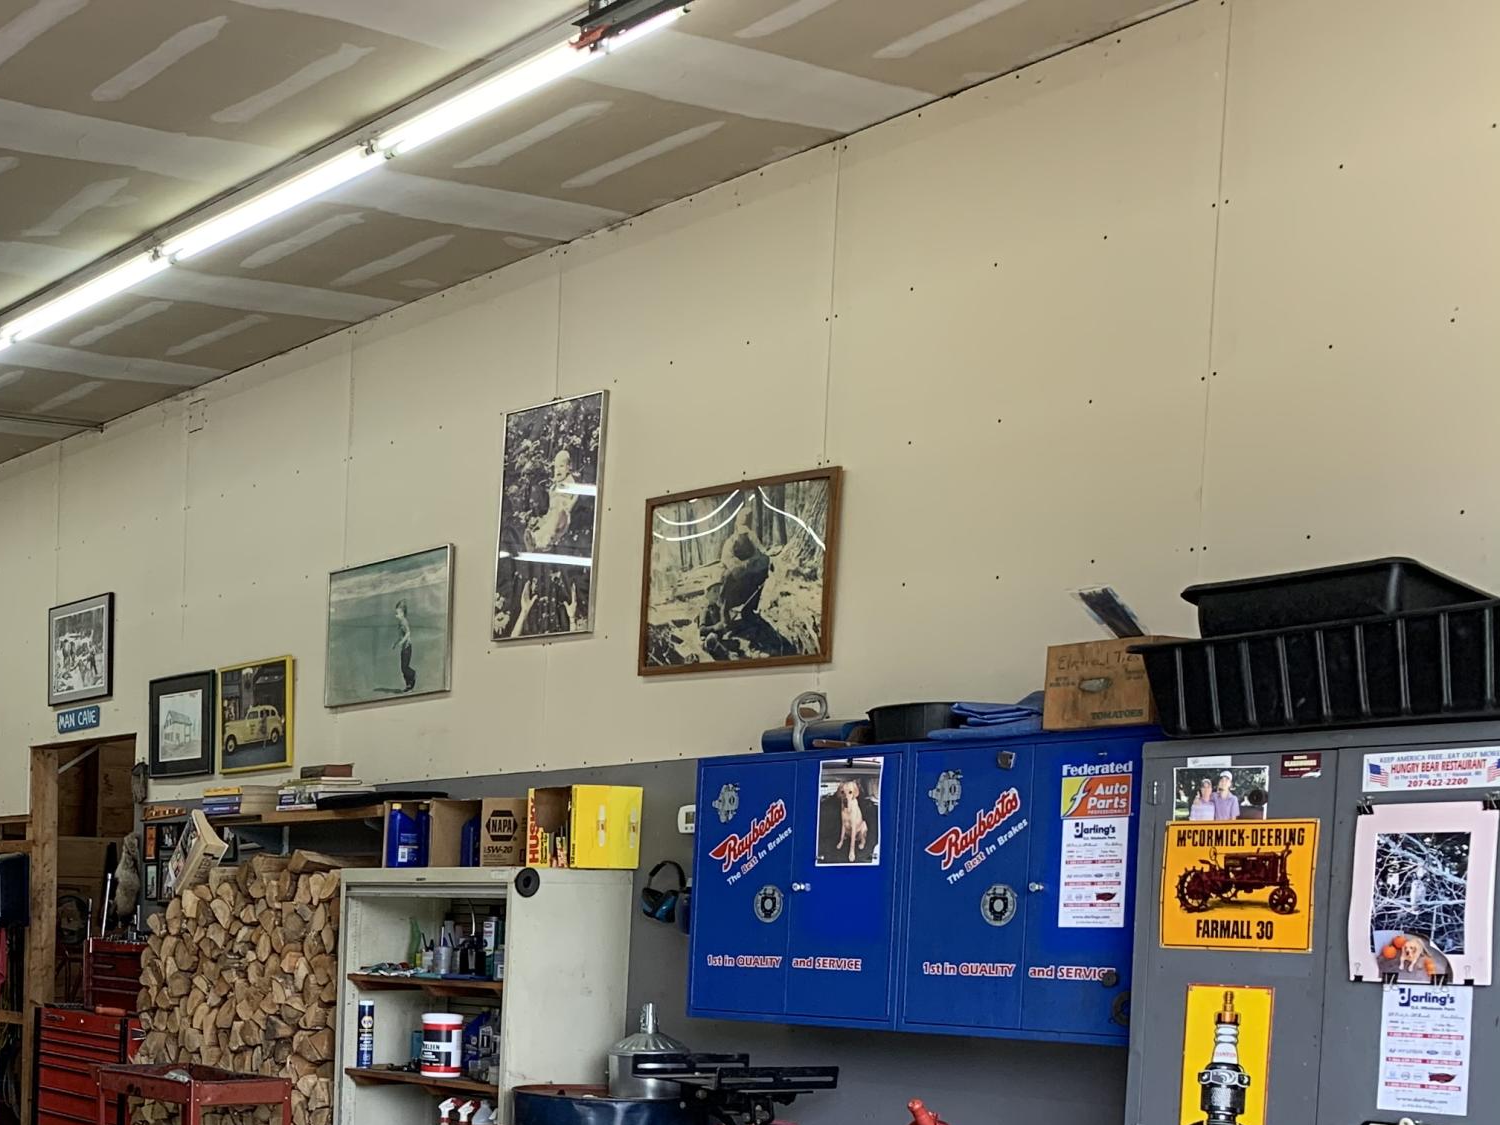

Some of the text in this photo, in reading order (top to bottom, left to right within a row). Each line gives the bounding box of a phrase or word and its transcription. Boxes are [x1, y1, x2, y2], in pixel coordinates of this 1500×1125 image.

[59, 713, 75, 729] MAN
[1091, 709, 1143, 719] TOMATOES
[1062, 761, 1133, 777] Federated
[1391, 759, 1488, 774] HUNGRY BEAR RESTAURANT
[1094, 782, 1128, 796] Auto
[1407, 778, 1468, 788] 207-422-2200
[1087, 796, 1127, 809] Parts
[490, 818, 513, 836] NAPA
[924, 787, 1021, 870] Raybestos
[708, 798, 787, 873] Raybestos
[487, 846, 513, 854] 5W-20
[727, 827, 793, 886] The Best In Brakes
[946, 818, 1029, 885] The Best In Brakes
[1196, 919, 1274, 940] FARMALL 30
[707, 954, 862, 971] 1st in QUALITY and SERVICE
[923, 962, 942, 975] 1st
[943, 962, 957, 975] in
[959, 963, 1016, 977] QUALITY
[1028, 966, 1056, 979] and
